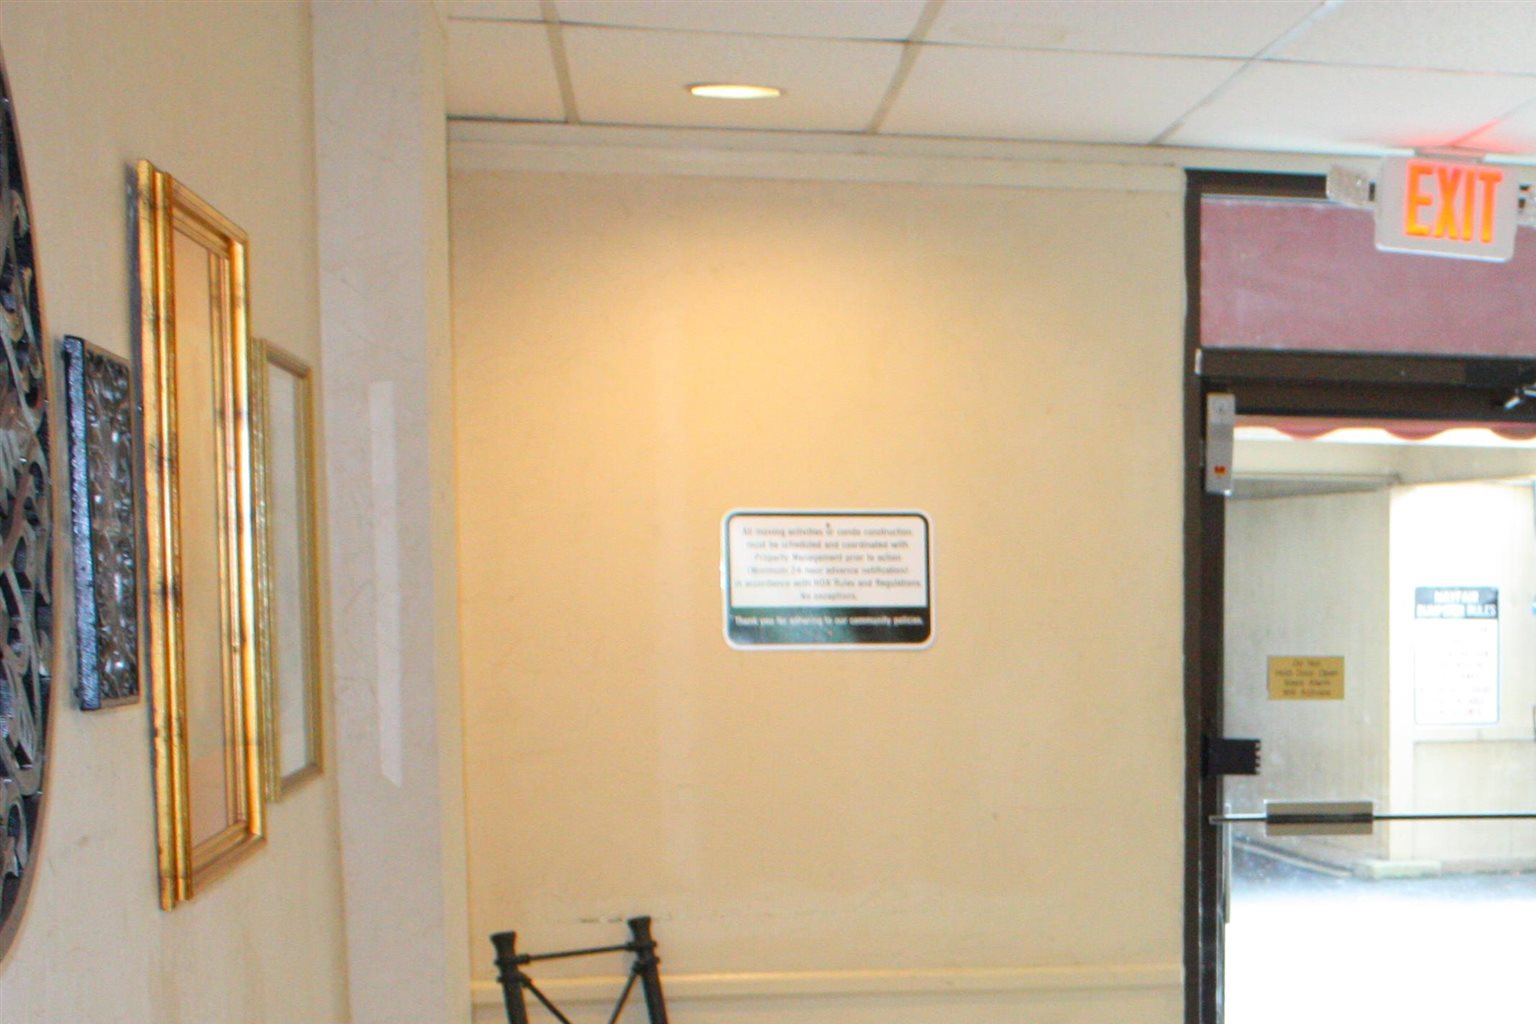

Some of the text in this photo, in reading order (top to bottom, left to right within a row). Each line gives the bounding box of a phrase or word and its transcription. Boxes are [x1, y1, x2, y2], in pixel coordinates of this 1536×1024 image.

[1405, 162, 1503, 244] EXIT
[756, 528, 785, 538] moving
[788, 527, 823, 537] activities
[863, 527, 913, 537] construction
[769, 541, 779, 550] be
[782, 541, 822, 550] scheduled
[825, 541, 839, 550] and
[841, 541, 888, 550] coordinated
[890, 541, 909, 550] with
[754, 554, 788, 563] Property
[792, 554, 843, 563] Management
[866, 554, 875, 562] to
[826, 566, 859, 575] advance
[745, 579, 790, 588] accordance
[793, 579, 811, 588] with
[834, 579, 855, 588] Rules
[858, 579, 873, 588] and
[734, 615, 758, 626] Thank
[760, 617, 775, 627] you
[824, 615, 833, 626] to
[834, 617, 848, 626] our
[849, 615, 891, 627] community
